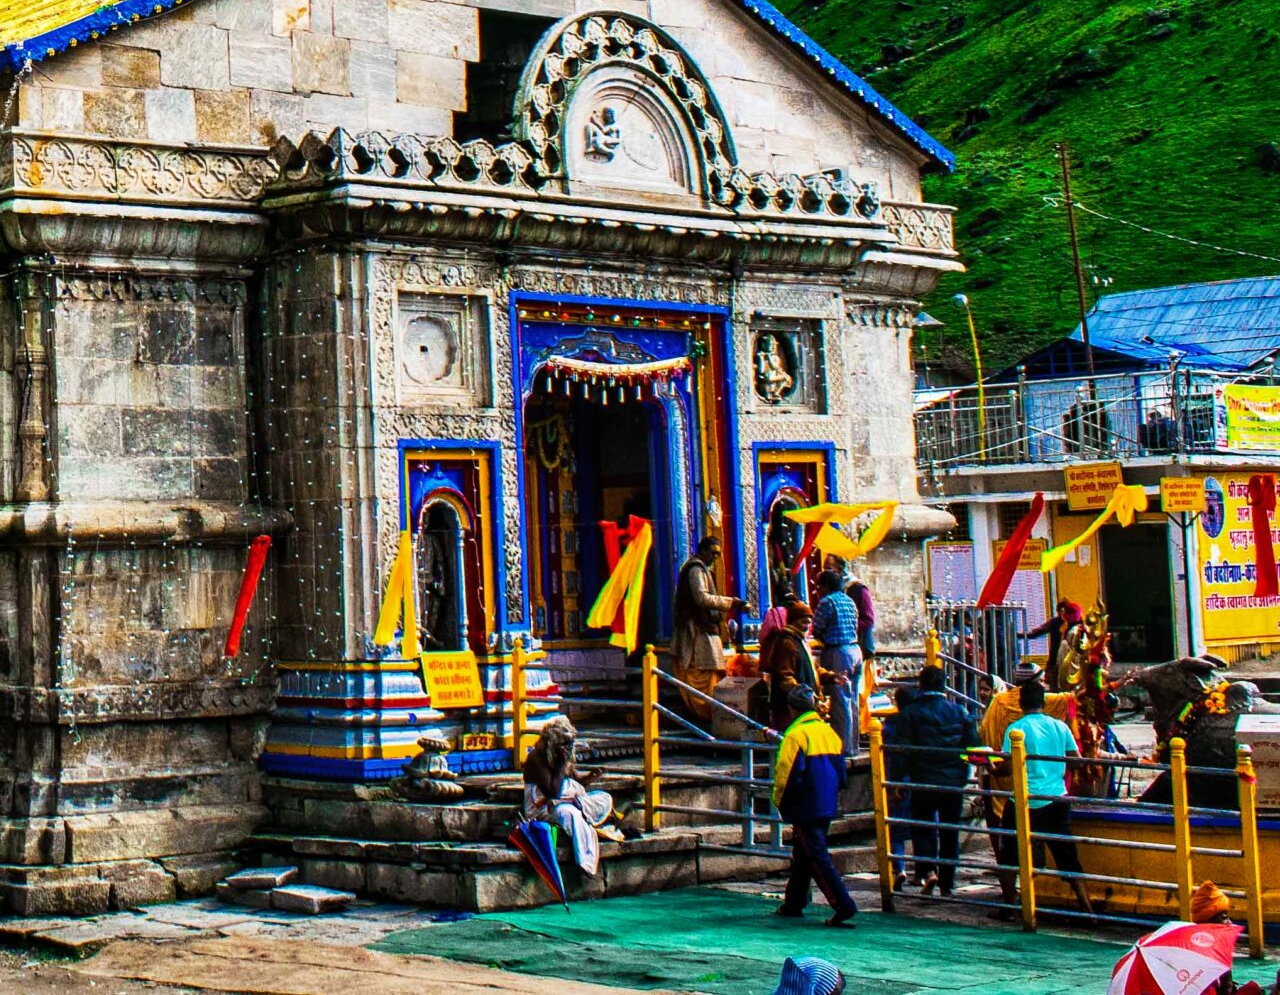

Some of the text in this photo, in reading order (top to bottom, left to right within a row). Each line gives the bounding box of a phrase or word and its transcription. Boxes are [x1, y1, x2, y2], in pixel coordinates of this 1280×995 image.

[1228, 480, 1236, 498] श्री
[1206, 593, 1225, 610] हार्दिक
[1227, 596, 1246, 609] स्वागत
